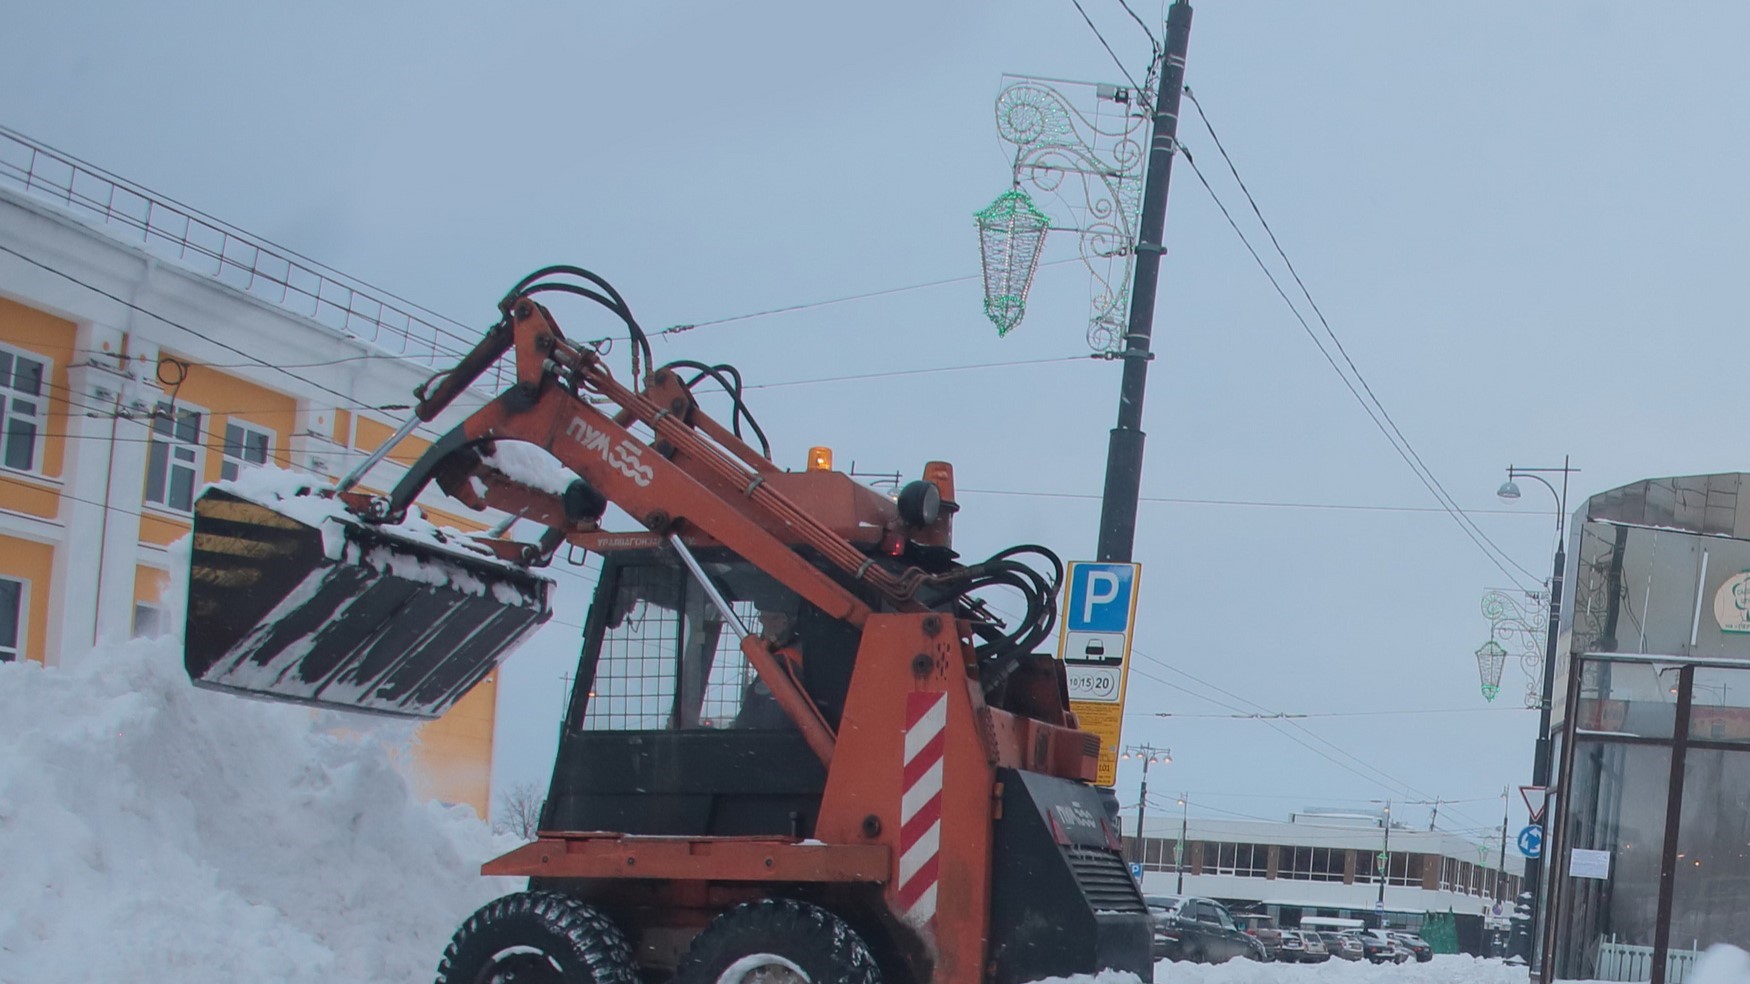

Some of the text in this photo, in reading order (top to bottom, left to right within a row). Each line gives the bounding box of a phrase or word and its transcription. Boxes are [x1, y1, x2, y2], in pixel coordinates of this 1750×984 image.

[1084, 571, 1119, 623] P
[1070, 677, 1110, 689] 10 15 20
